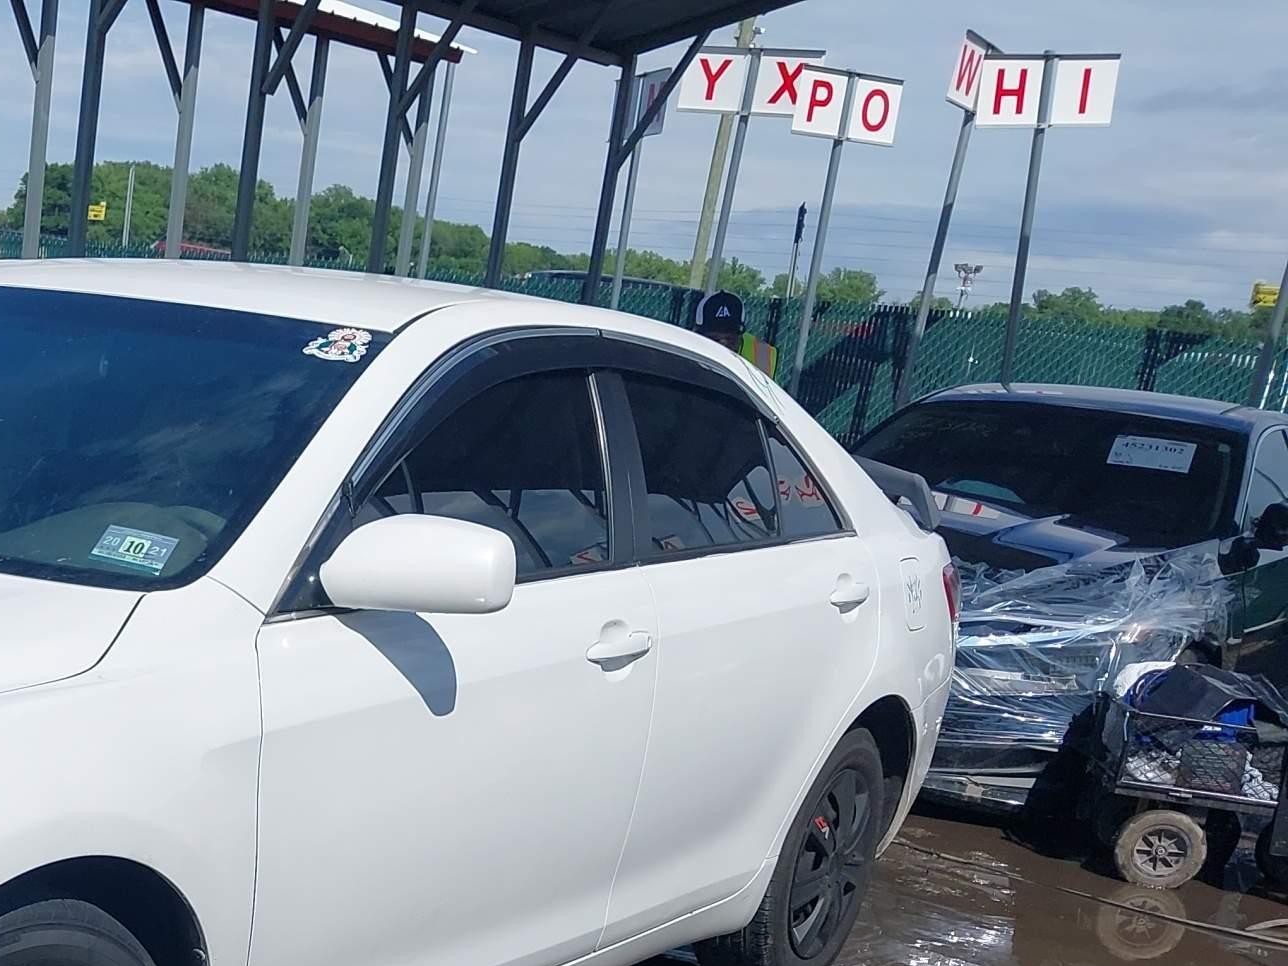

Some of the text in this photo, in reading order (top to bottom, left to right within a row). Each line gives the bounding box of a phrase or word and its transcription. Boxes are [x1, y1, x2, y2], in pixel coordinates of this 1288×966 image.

[699, 58, 733, 101] Y
[766, 61, 806, 105] X
[955, 44, 982, 97] W
[992, 68, 1029, 115] H
[1077, 67, 1092, 115] I
[806, 79, 834, 123] P
[103, 535, 121, 547] 20
[123, 540, 145, 556] 10
[148, 546, 168, 562] 21
